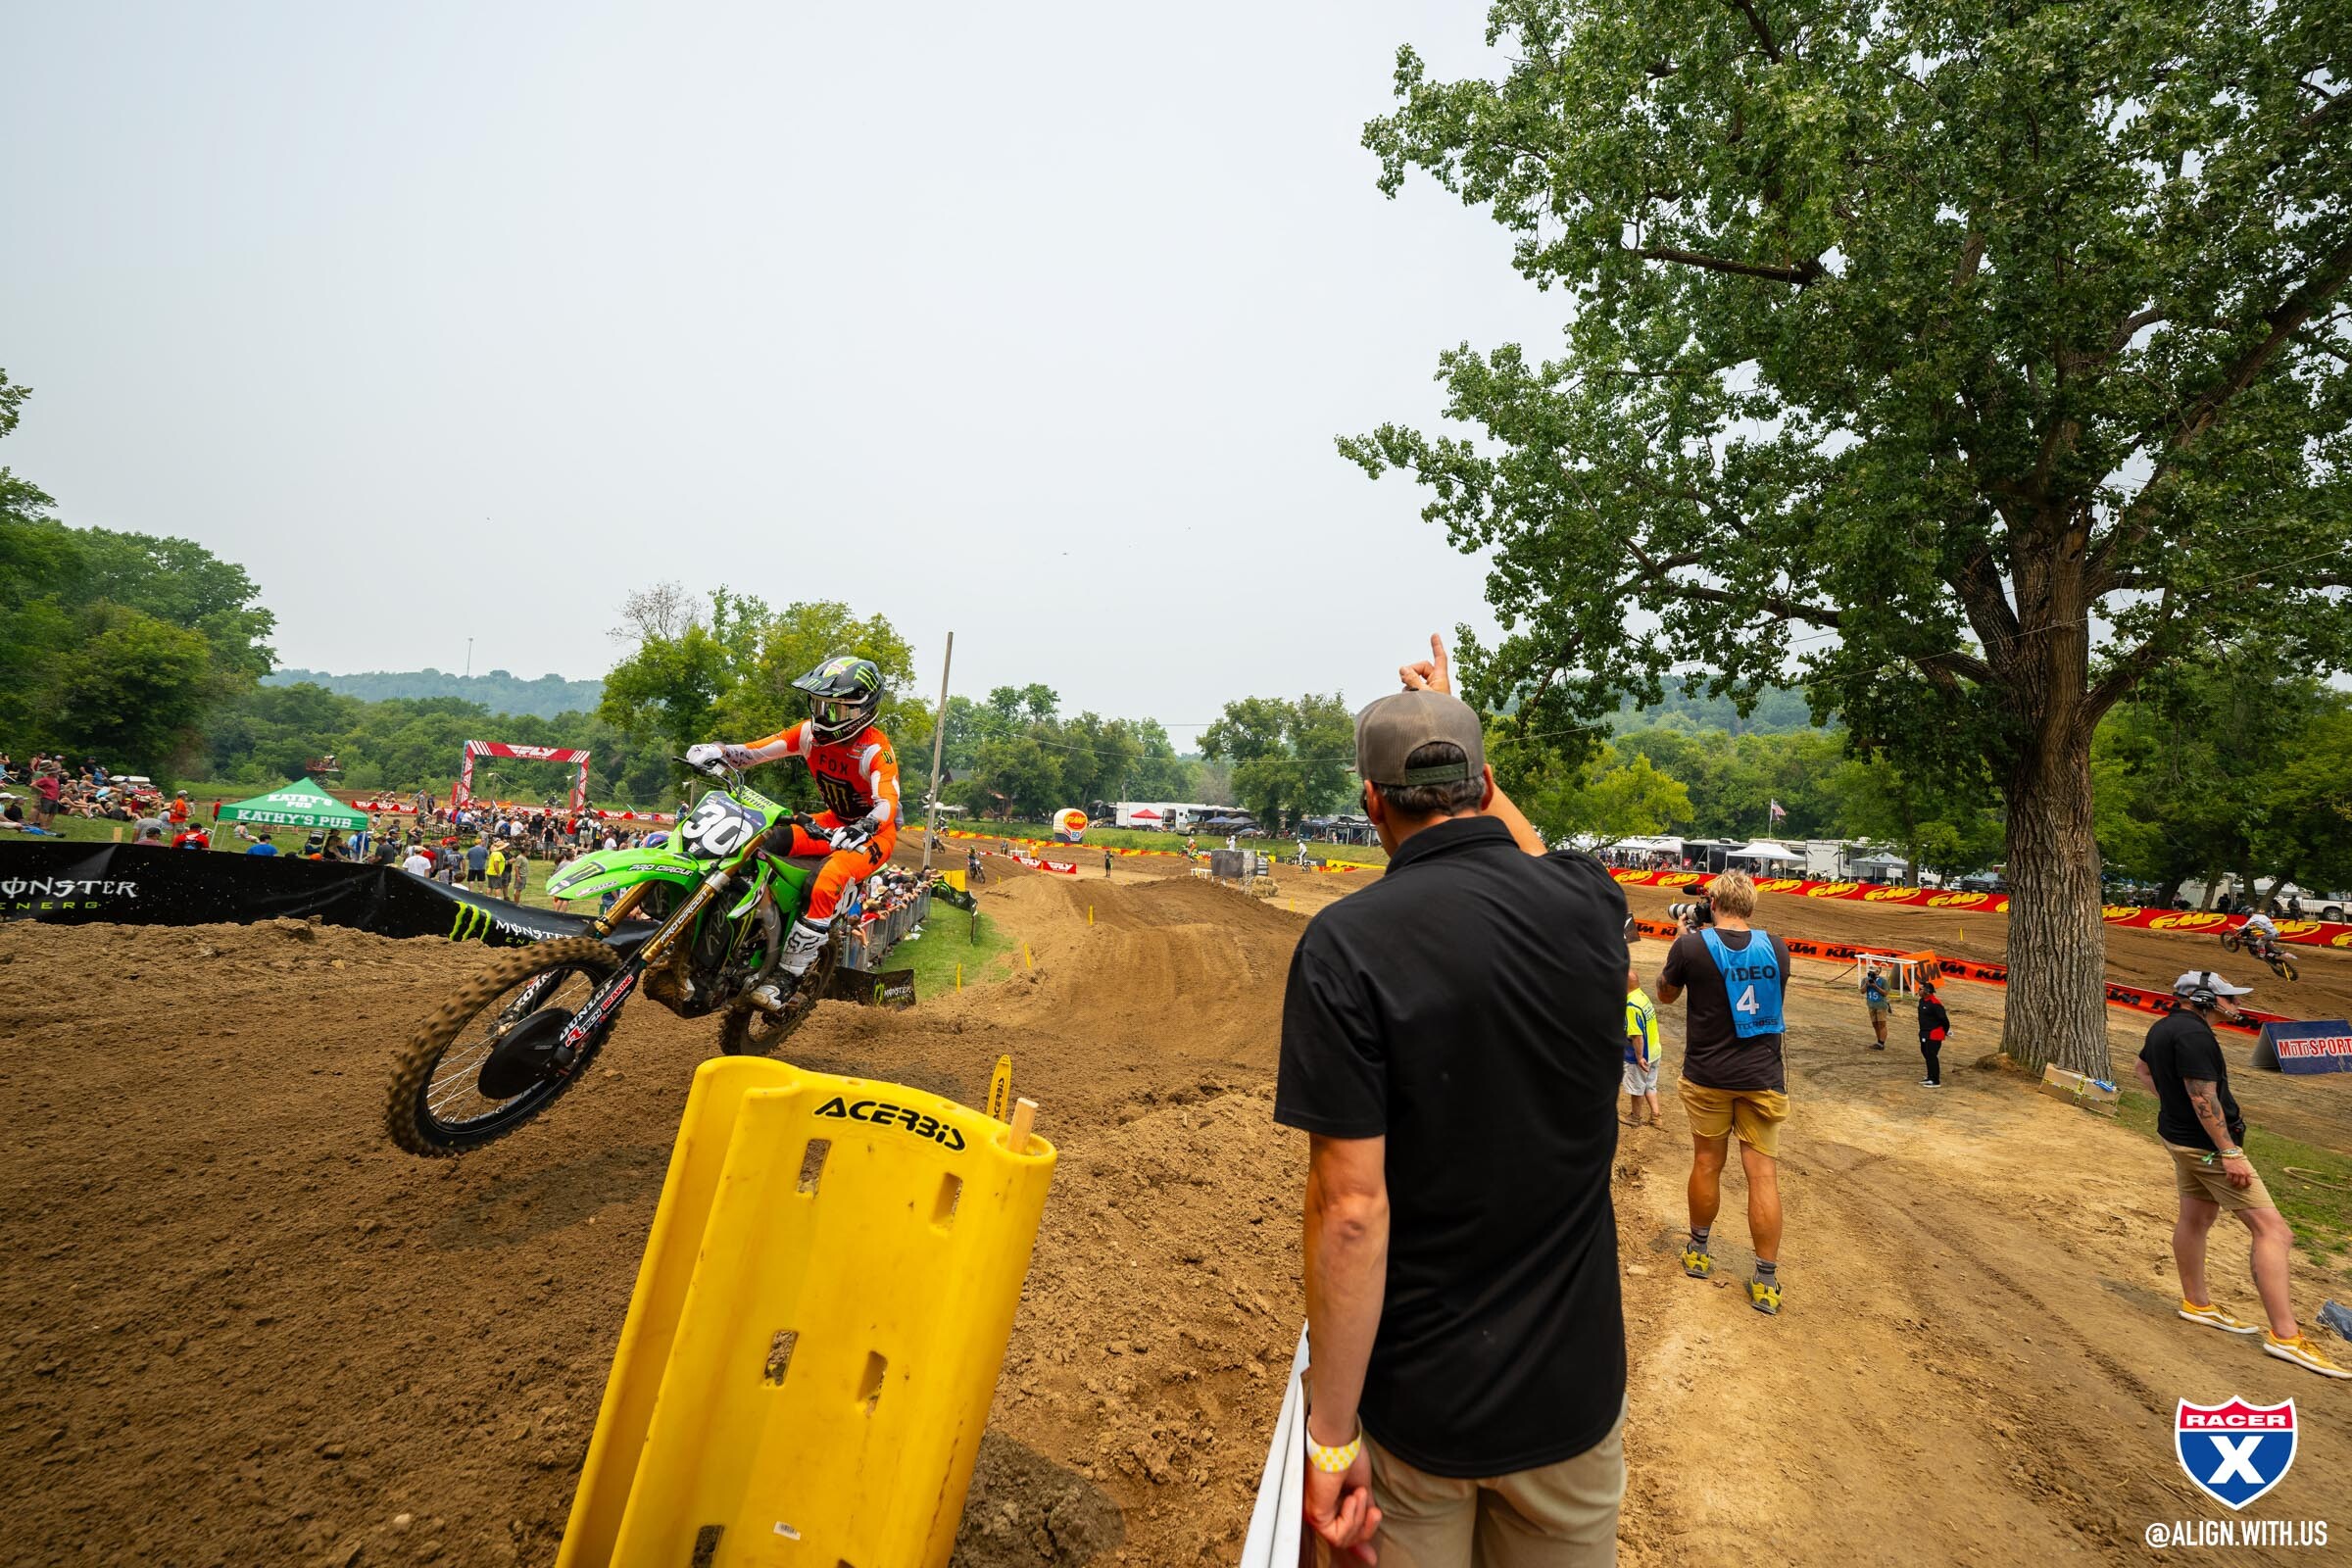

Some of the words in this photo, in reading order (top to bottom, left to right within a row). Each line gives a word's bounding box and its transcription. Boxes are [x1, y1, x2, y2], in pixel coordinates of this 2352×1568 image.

[506, 745, 559, 757] FLY
[819, 754, 849, 775] FOX
[267, 794, 333, 807] KATHY'S
[236, 809, 315, 825] KATHY'S
[318, 815, 352, 828] PUB
[1065, 815, 1086, 824] FMF
[682, 804, 754, 856] 30
[655, 864, 694, 877] CIRCUIT
[1614, 870, 1651, 883] FMF
[0, 876, 138, 899] ONSTER
[1657, 873, 1698, 887] FMF
[1756, 879, 1800, 892] FMF
[1807, 883, 1858, 897] FMF
[1865, 887, 1920, 902] FMF
[1928, 893, 1987, 907] FMF
[659, 923, 678, 943] PRO
[676, 890, 708, 926] CIRCUIT
[2101, 906, 2138, 918] MF
[1637, 922, 1654, 934] TM
[2150, 912, 2226, 929] FMF
[1907, 958, 1941, 982] KTM
[1940, 960, 1966, 975] TM
[602, 974, 634, 1010] BRAKING
[2106, 988, 2141, 1005] TM
[1736, 985, 1760, 1015] 4
[560, 979, 613, 1041] DUNLOP
[813, 1097, 966, 1152] ACERBIS
